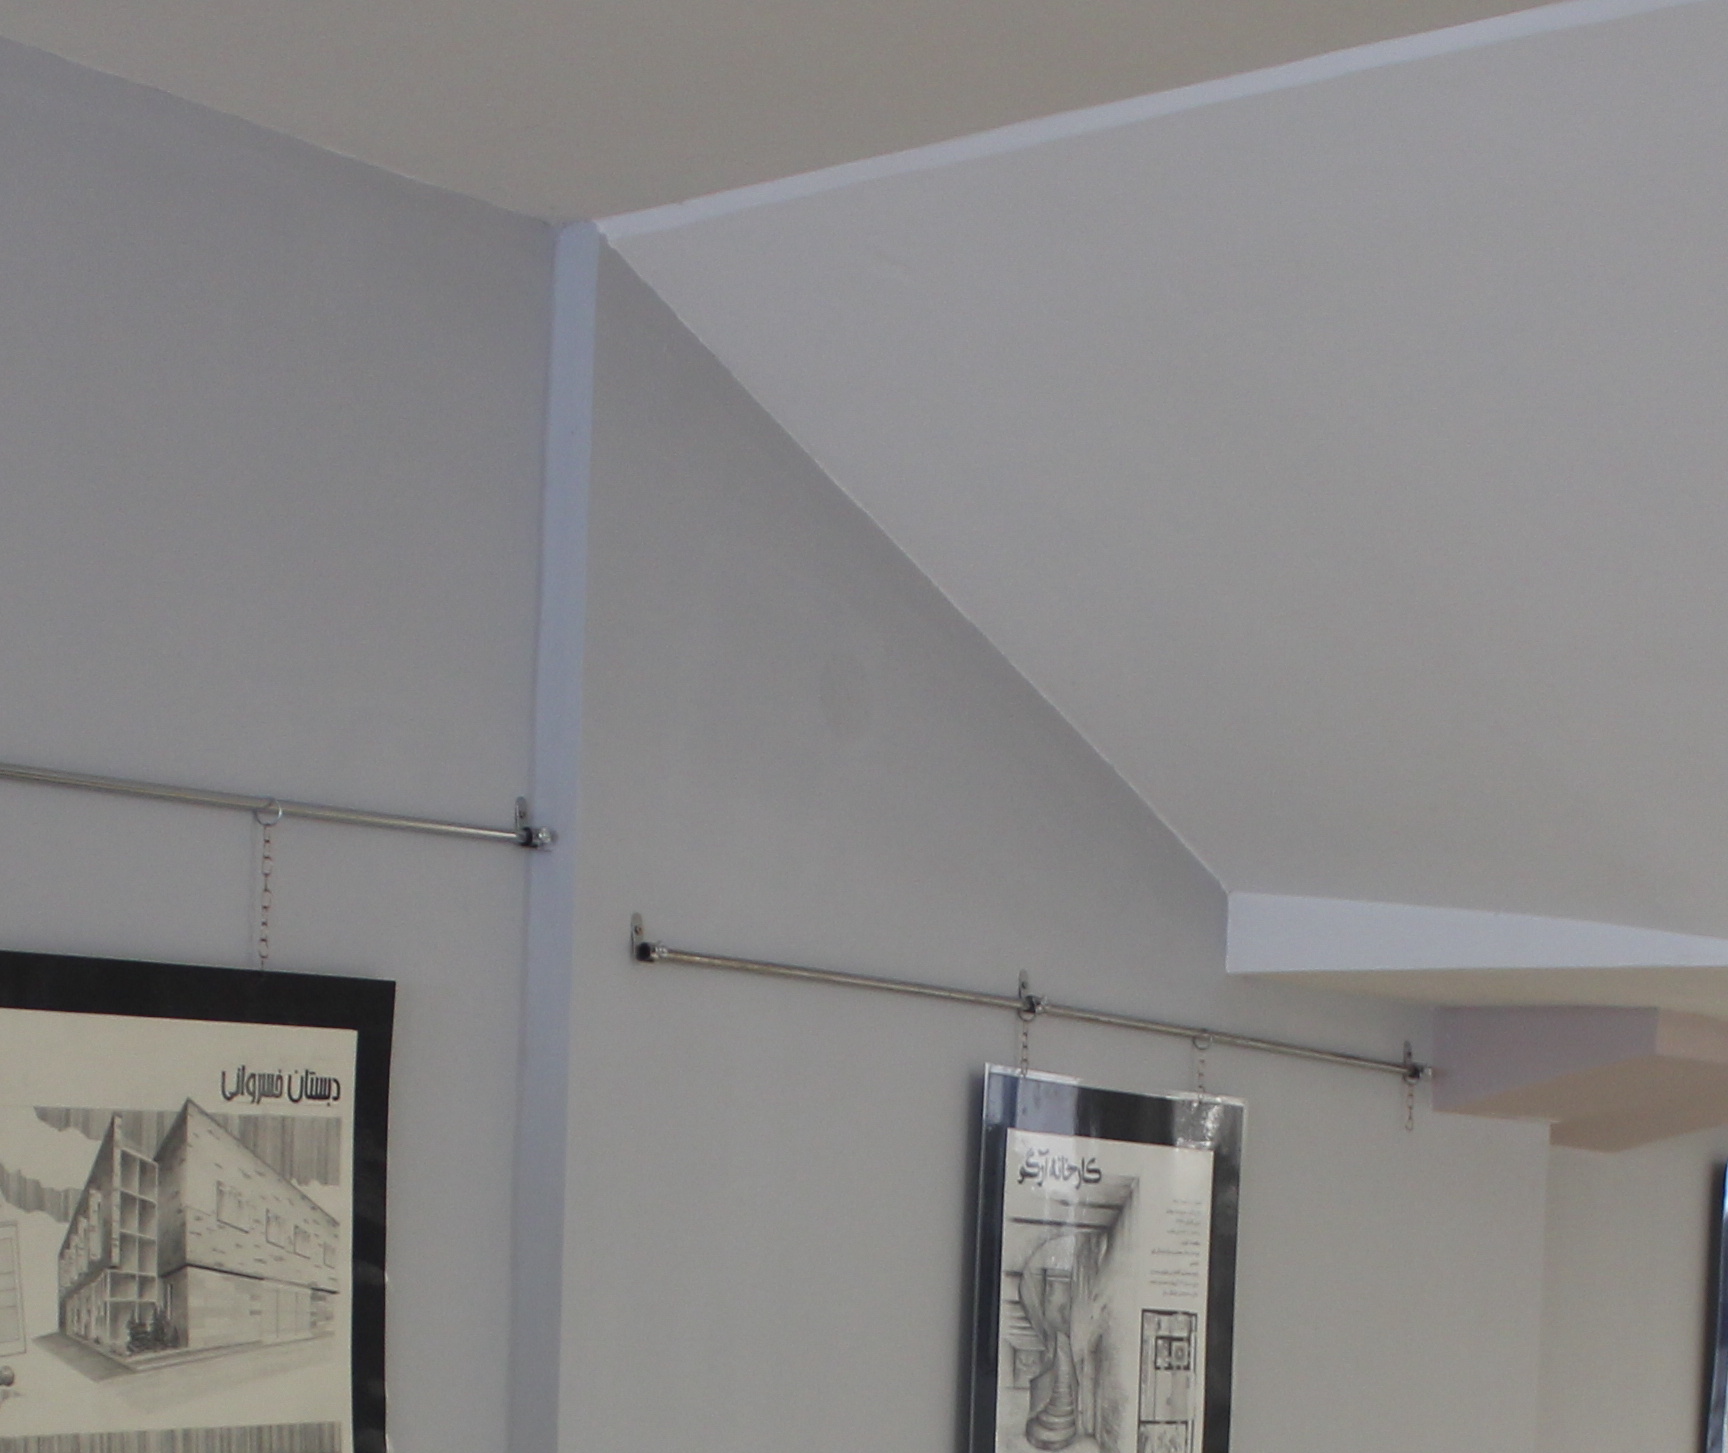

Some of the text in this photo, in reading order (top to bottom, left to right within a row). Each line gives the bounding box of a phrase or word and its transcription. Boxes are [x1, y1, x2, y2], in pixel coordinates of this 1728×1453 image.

[221, 1065, 341, 1107] دبستان خسروانی
[1049, 1155, 1101, 1190] کارخانه
